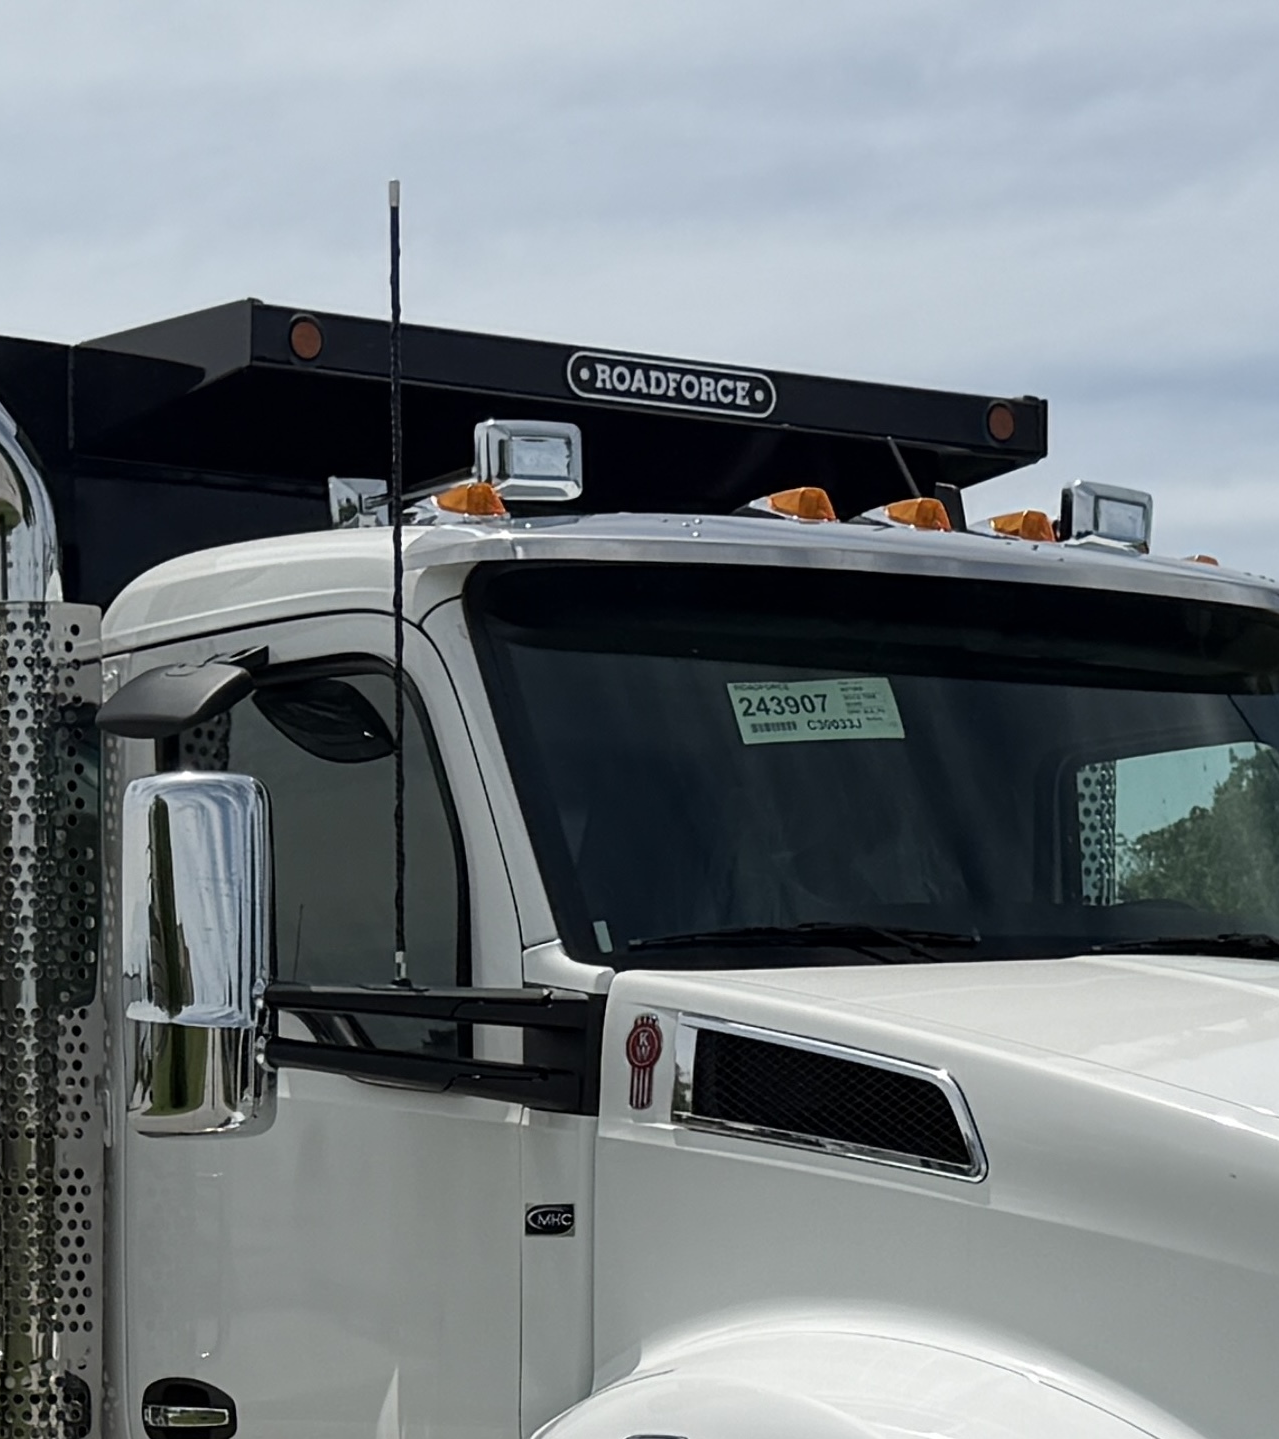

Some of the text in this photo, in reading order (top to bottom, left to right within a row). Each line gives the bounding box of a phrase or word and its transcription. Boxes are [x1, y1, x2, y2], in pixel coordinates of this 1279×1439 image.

[594, 362, 751, 407] ROADFORCE
[738, 693, 828, 718] 243907
[537, 1213, 573, 1227] MHC
